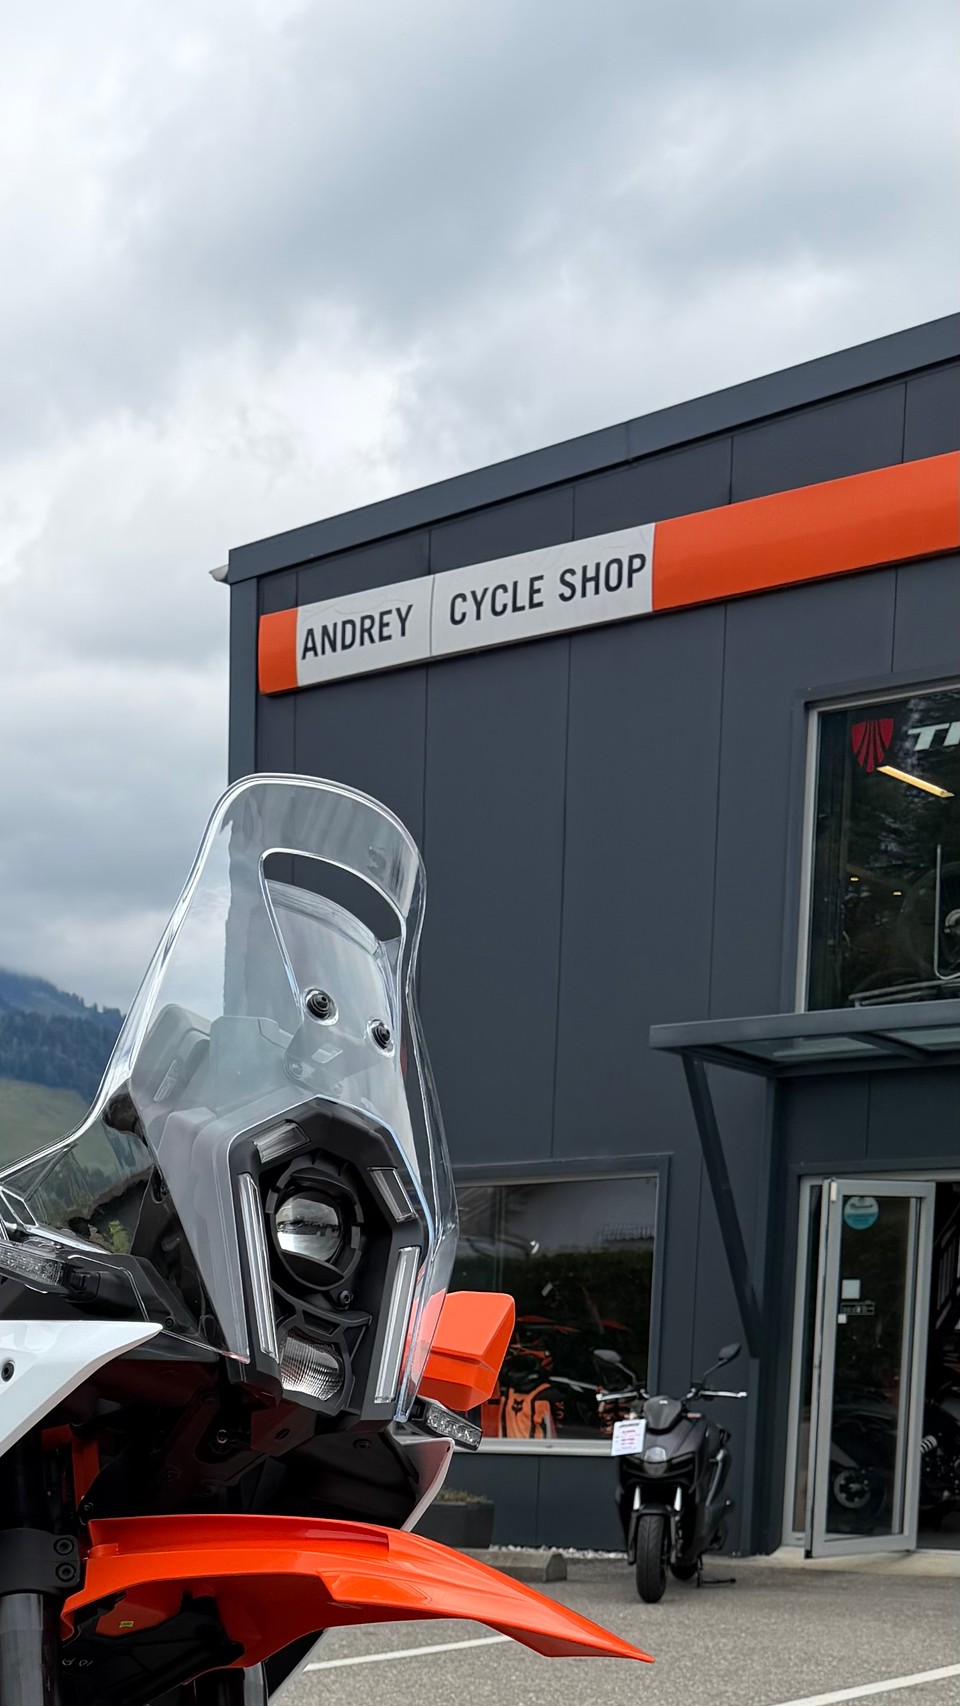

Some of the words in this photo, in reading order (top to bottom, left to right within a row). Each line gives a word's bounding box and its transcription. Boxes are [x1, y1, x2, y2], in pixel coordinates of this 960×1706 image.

[301, 604, 414, 661] ANDREY
[449, 575, 545, 626] CYCLE
[558, 553, 647, 603] SHOP
